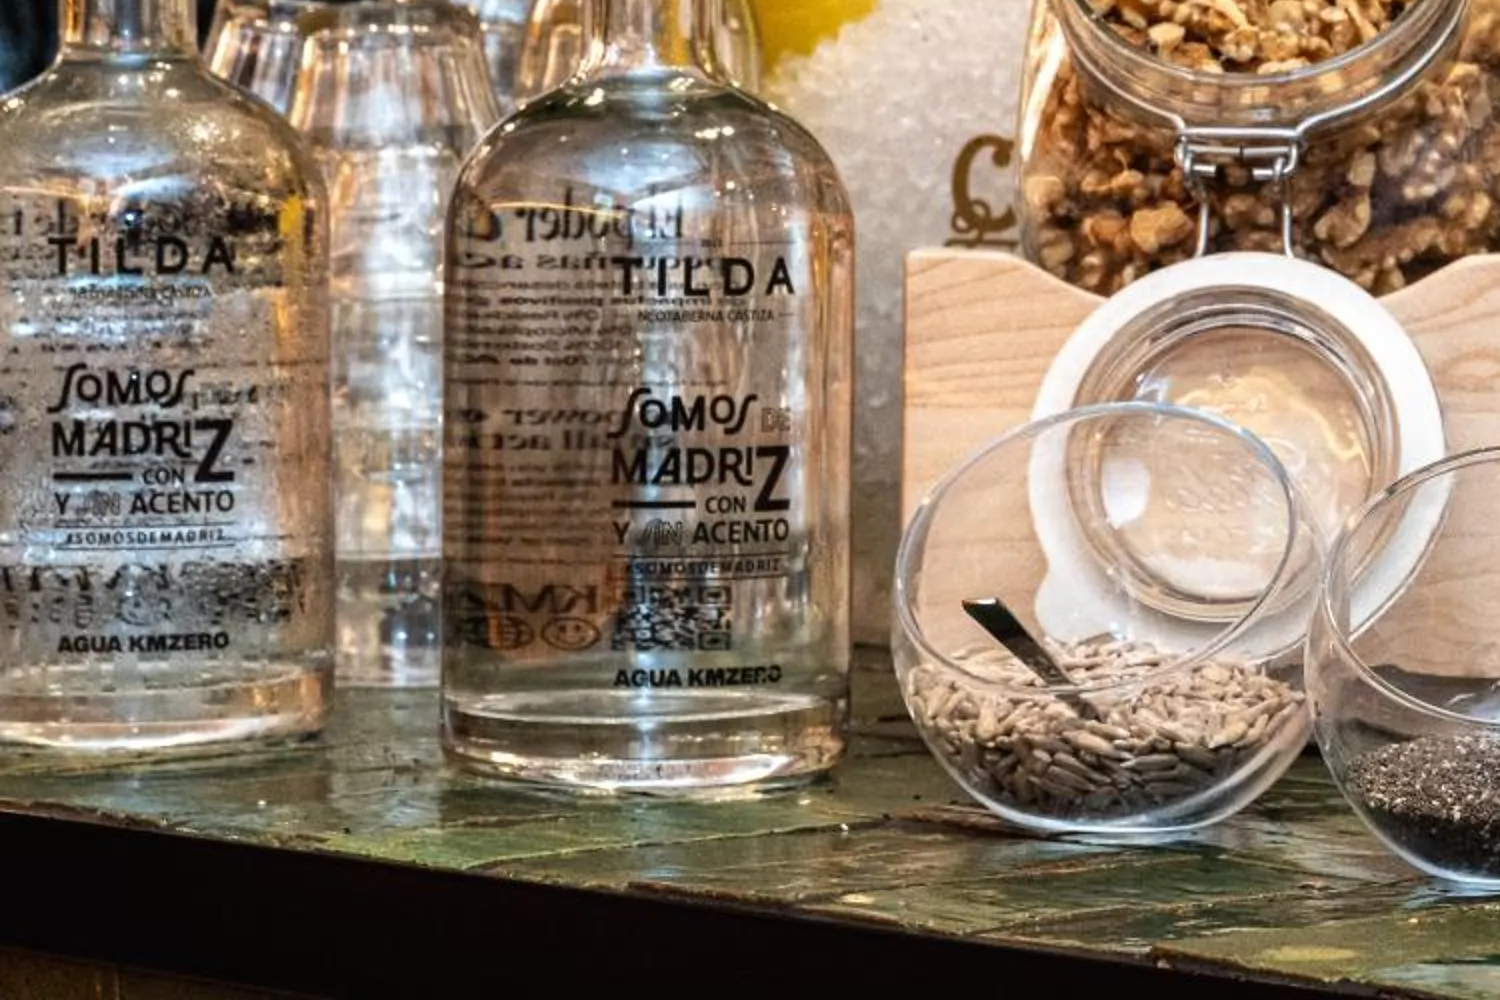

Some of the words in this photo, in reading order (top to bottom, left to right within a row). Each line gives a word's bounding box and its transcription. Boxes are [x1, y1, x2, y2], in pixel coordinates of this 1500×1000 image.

[48, 236, 234, 275] TILDA
[611, 256, 795, 296] TILDA
[47, 362, 195, 413] SOMOS
[606, 387, 758, 439] SOMOS
[52, 418, 235, 482] MADRIZ
[143, 467, 185, 485] CON
[611, 446, 791, 513] MADRIZ
[54, 492, 71, 515] Y
[130, 490, 235, 515] ACENTO
[704, 495, 748, 514] CON
[612, 521, 631, 545] Y
[691, 518, 790, 545] ACENTO
[58, 634, 122, 653] AGUA
[129, 631, 230, 652] KMZERO
[613, 669, 683, 688] AGUA
[688, 664, 783, 687] KMZERO
